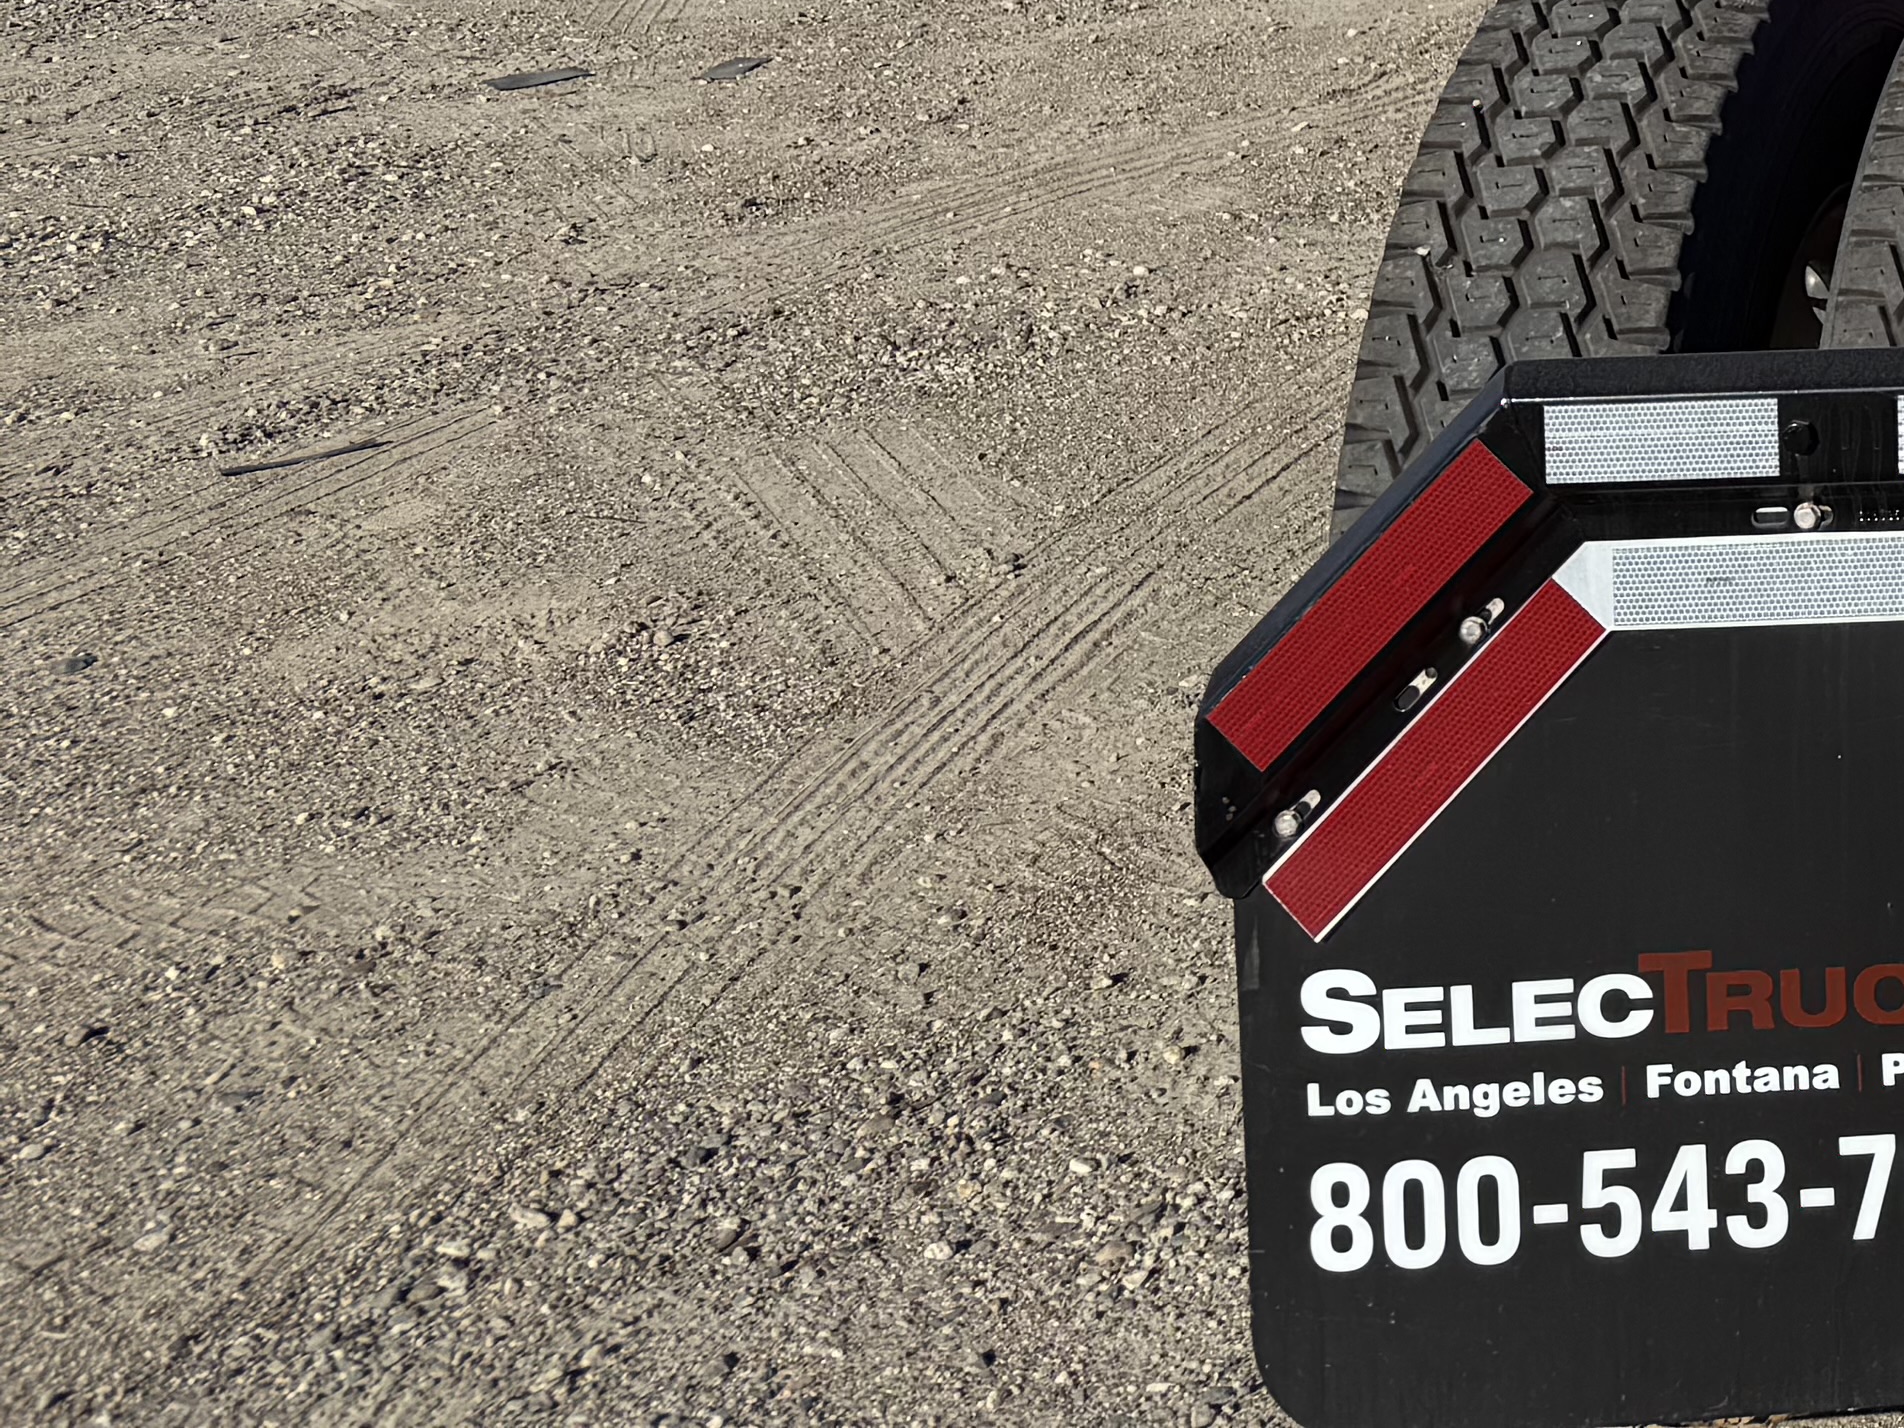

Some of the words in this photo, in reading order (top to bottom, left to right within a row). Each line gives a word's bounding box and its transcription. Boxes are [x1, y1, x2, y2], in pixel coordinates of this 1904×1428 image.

[1306, 1083, 1391, 1117] Los
[1407, 1072, 1603, 1118] Angeles
[1646, 1061, 1840, 1098] Fontana
